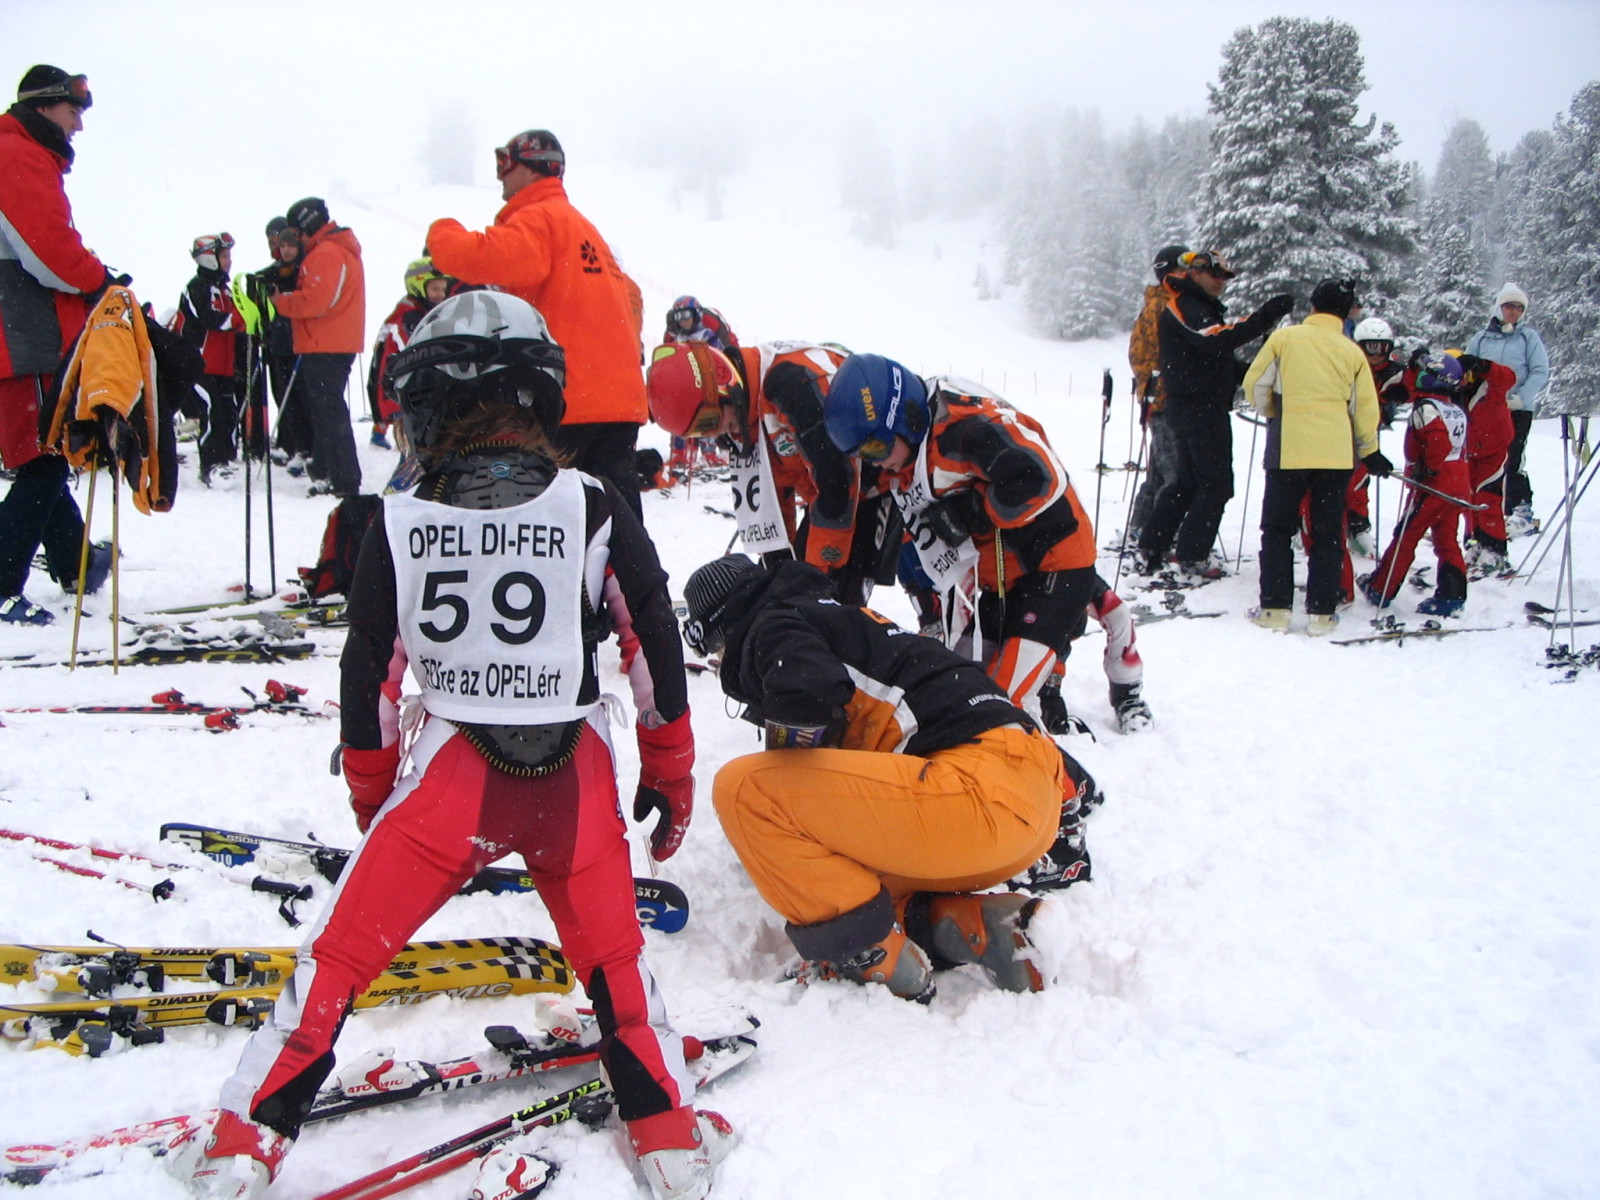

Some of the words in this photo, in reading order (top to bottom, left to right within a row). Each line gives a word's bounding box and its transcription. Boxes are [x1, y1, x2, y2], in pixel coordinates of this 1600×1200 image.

[861, 386, 876, 421] uvex
[409, 523, 472, 559] OPEL
[481, 522, 565, 559] DI-FER
[418, 569, 547, 645] 59
[460, 669, 480, 696] az
[486, 662, 562, 699] OPELért
[151, 948, 220, 956] ATOMIC
[148, 993, 219, 1007] ATOMIC
